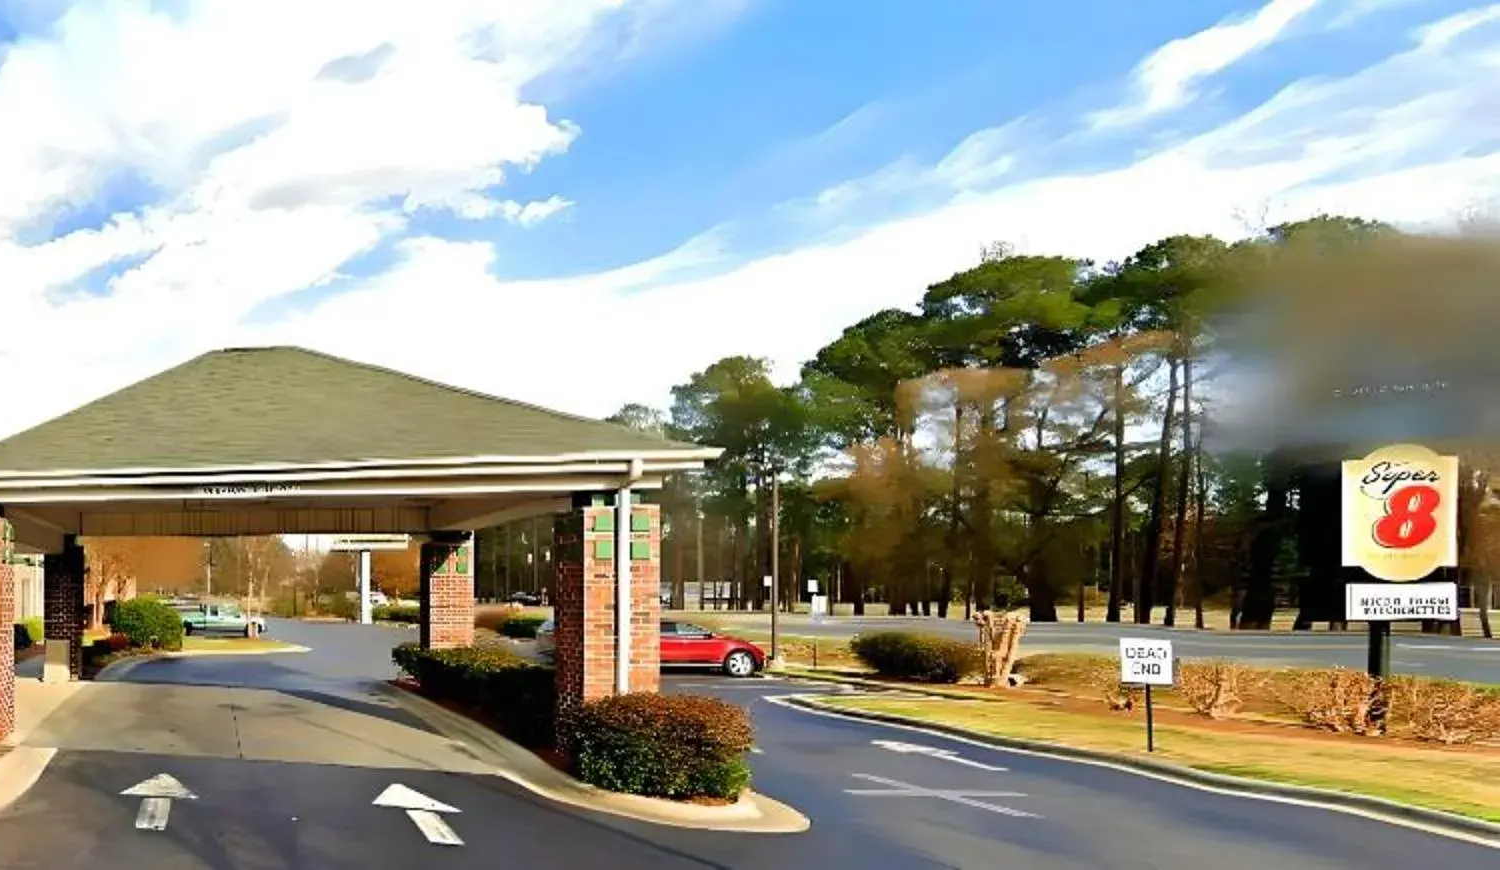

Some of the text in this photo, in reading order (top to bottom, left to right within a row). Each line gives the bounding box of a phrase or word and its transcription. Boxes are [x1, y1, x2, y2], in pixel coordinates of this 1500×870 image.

[1361, 461, 1441, 496] Super
[1371, 485, 1441, 549] 8
[1125, 647, 1168, 659] DEAD
[1132, 661, 1161, 675] END
